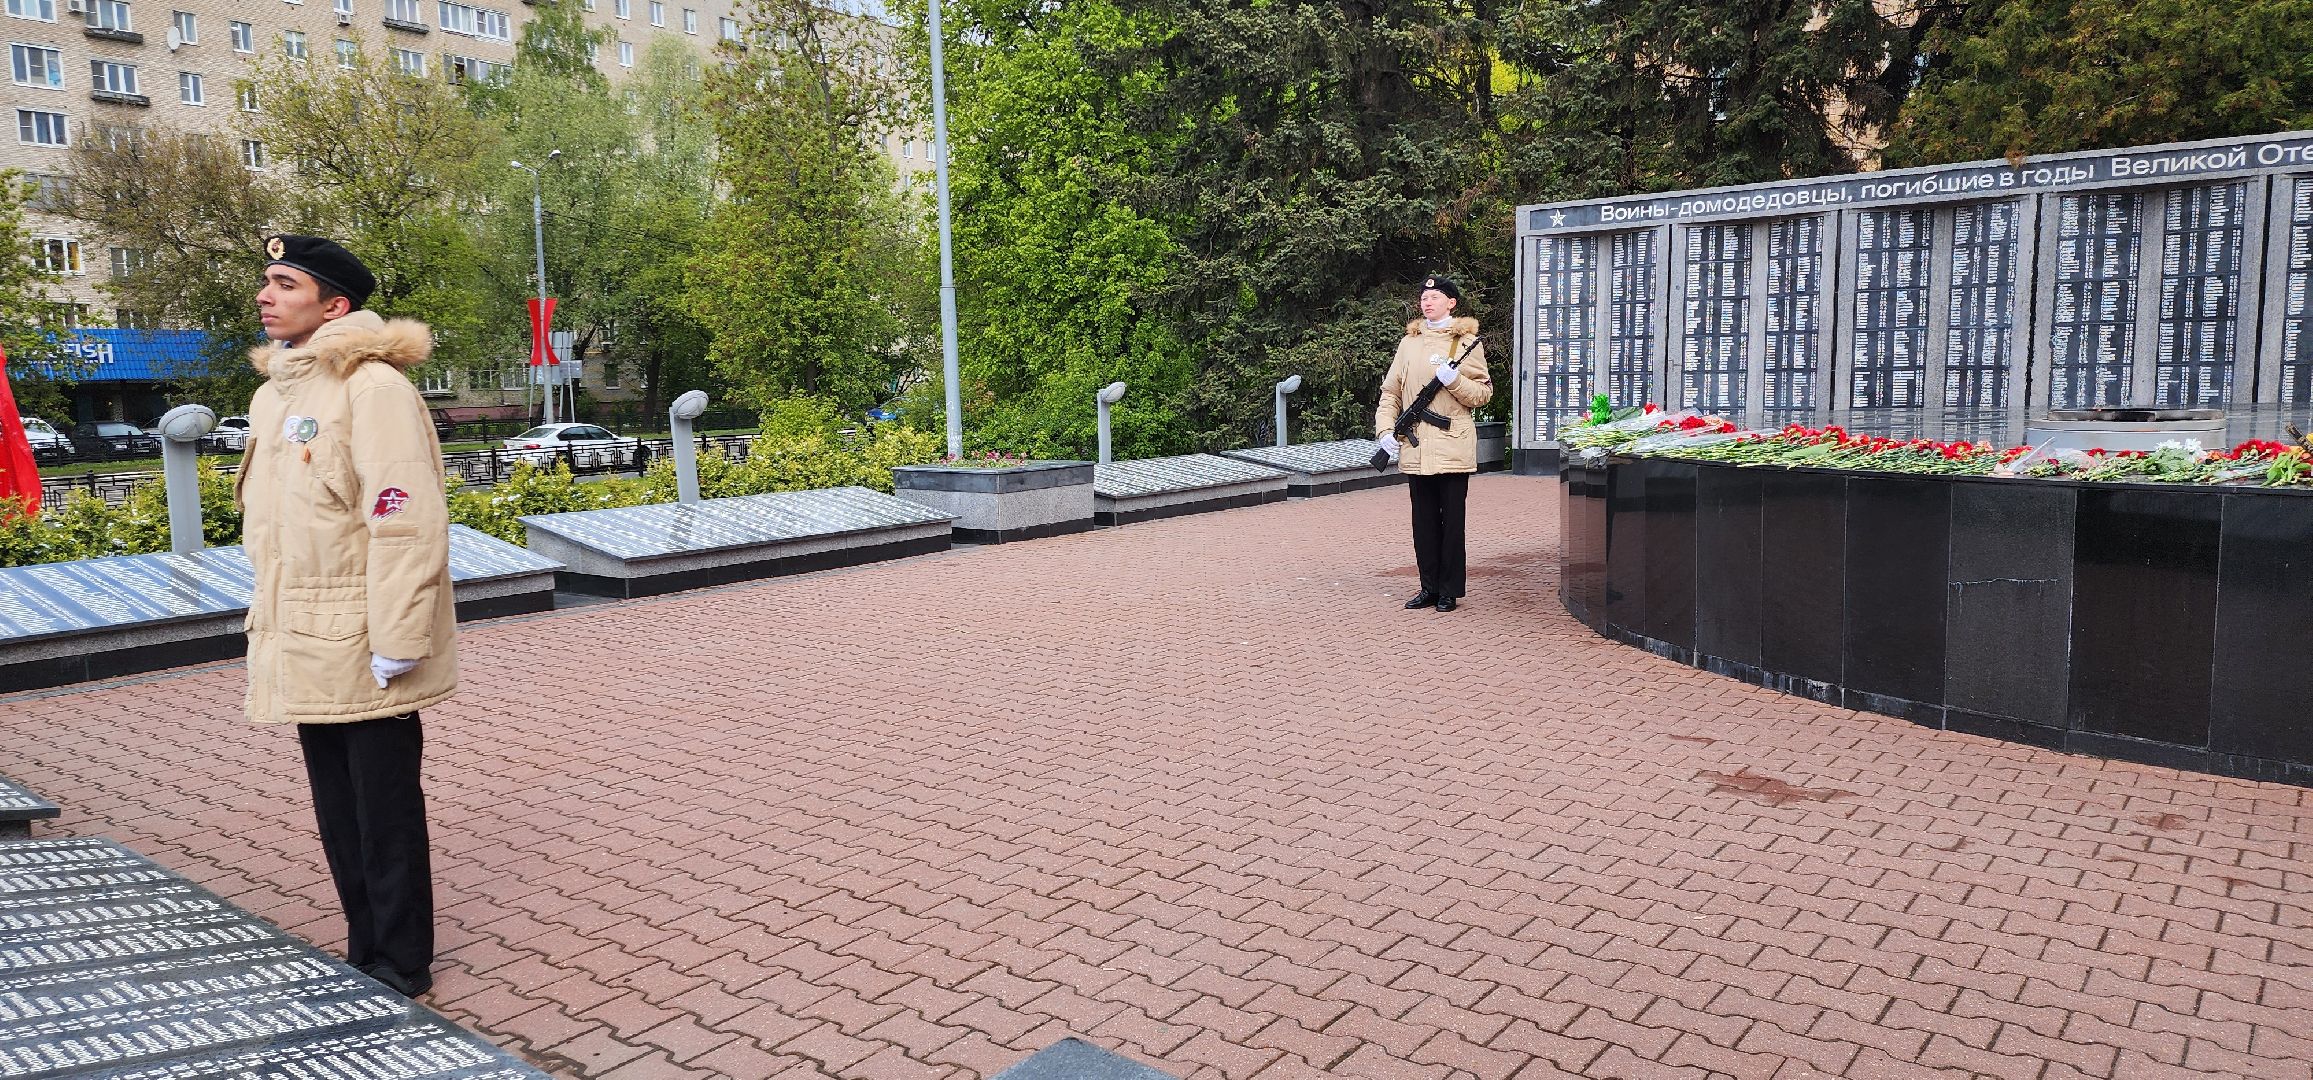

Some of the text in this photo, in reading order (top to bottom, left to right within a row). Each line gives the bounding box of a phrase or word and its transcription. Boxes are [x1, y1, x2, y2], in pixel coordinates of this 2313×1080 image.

[1600, 186, 1853, 222] Воины-домодедовцы,
[1861, 173, 1994, 199] погибшие
[1999, 170, 2015, 187] в
[2022, 164, 2094, 186] годы
[2111, 145, 2247, 177] Великой
